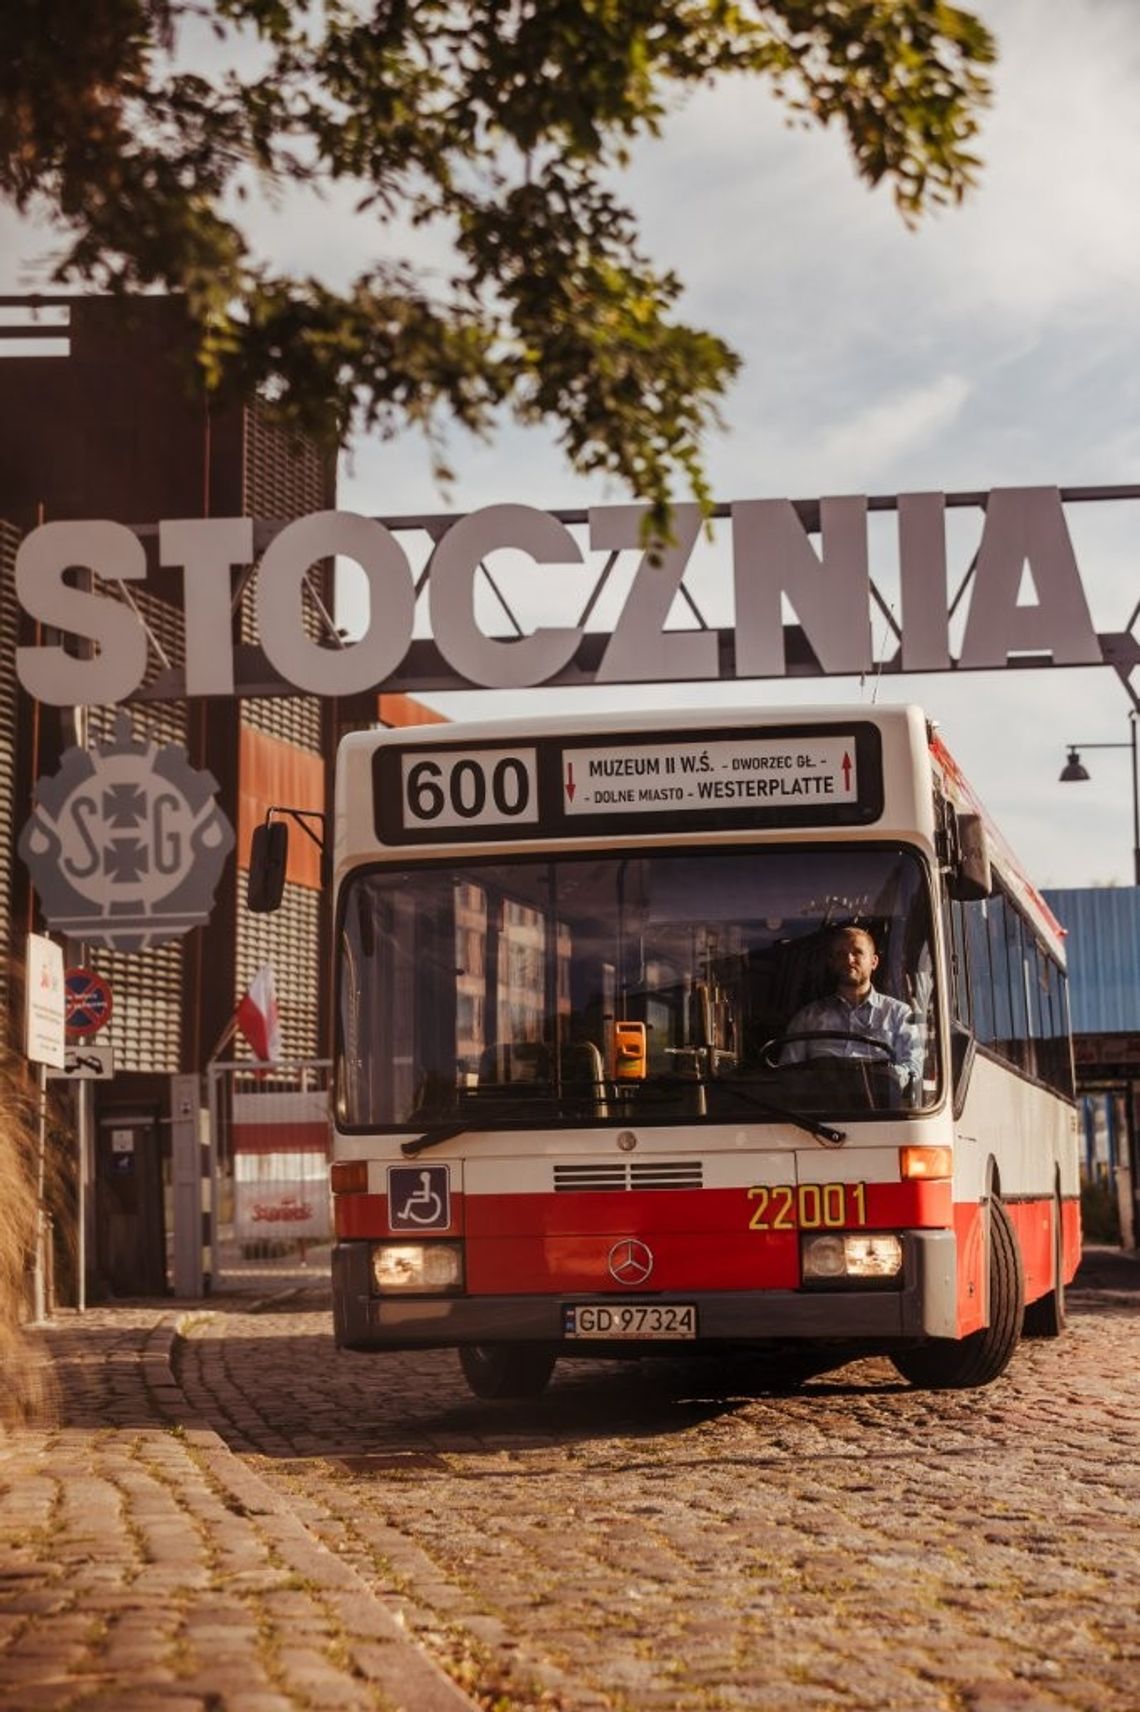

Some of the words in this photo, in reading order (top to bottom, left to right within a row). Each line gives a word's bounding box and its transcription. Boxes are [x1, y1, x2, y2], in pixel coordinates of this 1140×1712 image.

[14, 486, 1103, 707] STOCZNIA
[589, 758, 660, 777] MUZEUM
[665, 757, 675, 774] II
[680, 750, 714, 773] W.Ś.
[732, 755, 792, 771] DWORZEC
[406, 757, 529, 821] 600
[594, 789, 635, 804] DOLNE
[638, 787, 684, 802] MIASTO
[697, 776, 834, 799] WESTERPLATTE
[747, 1182, 866, 1230] 22001
[580, 1308, 612, 1332] GD
[621, 1308, 692, 1332] 97324
